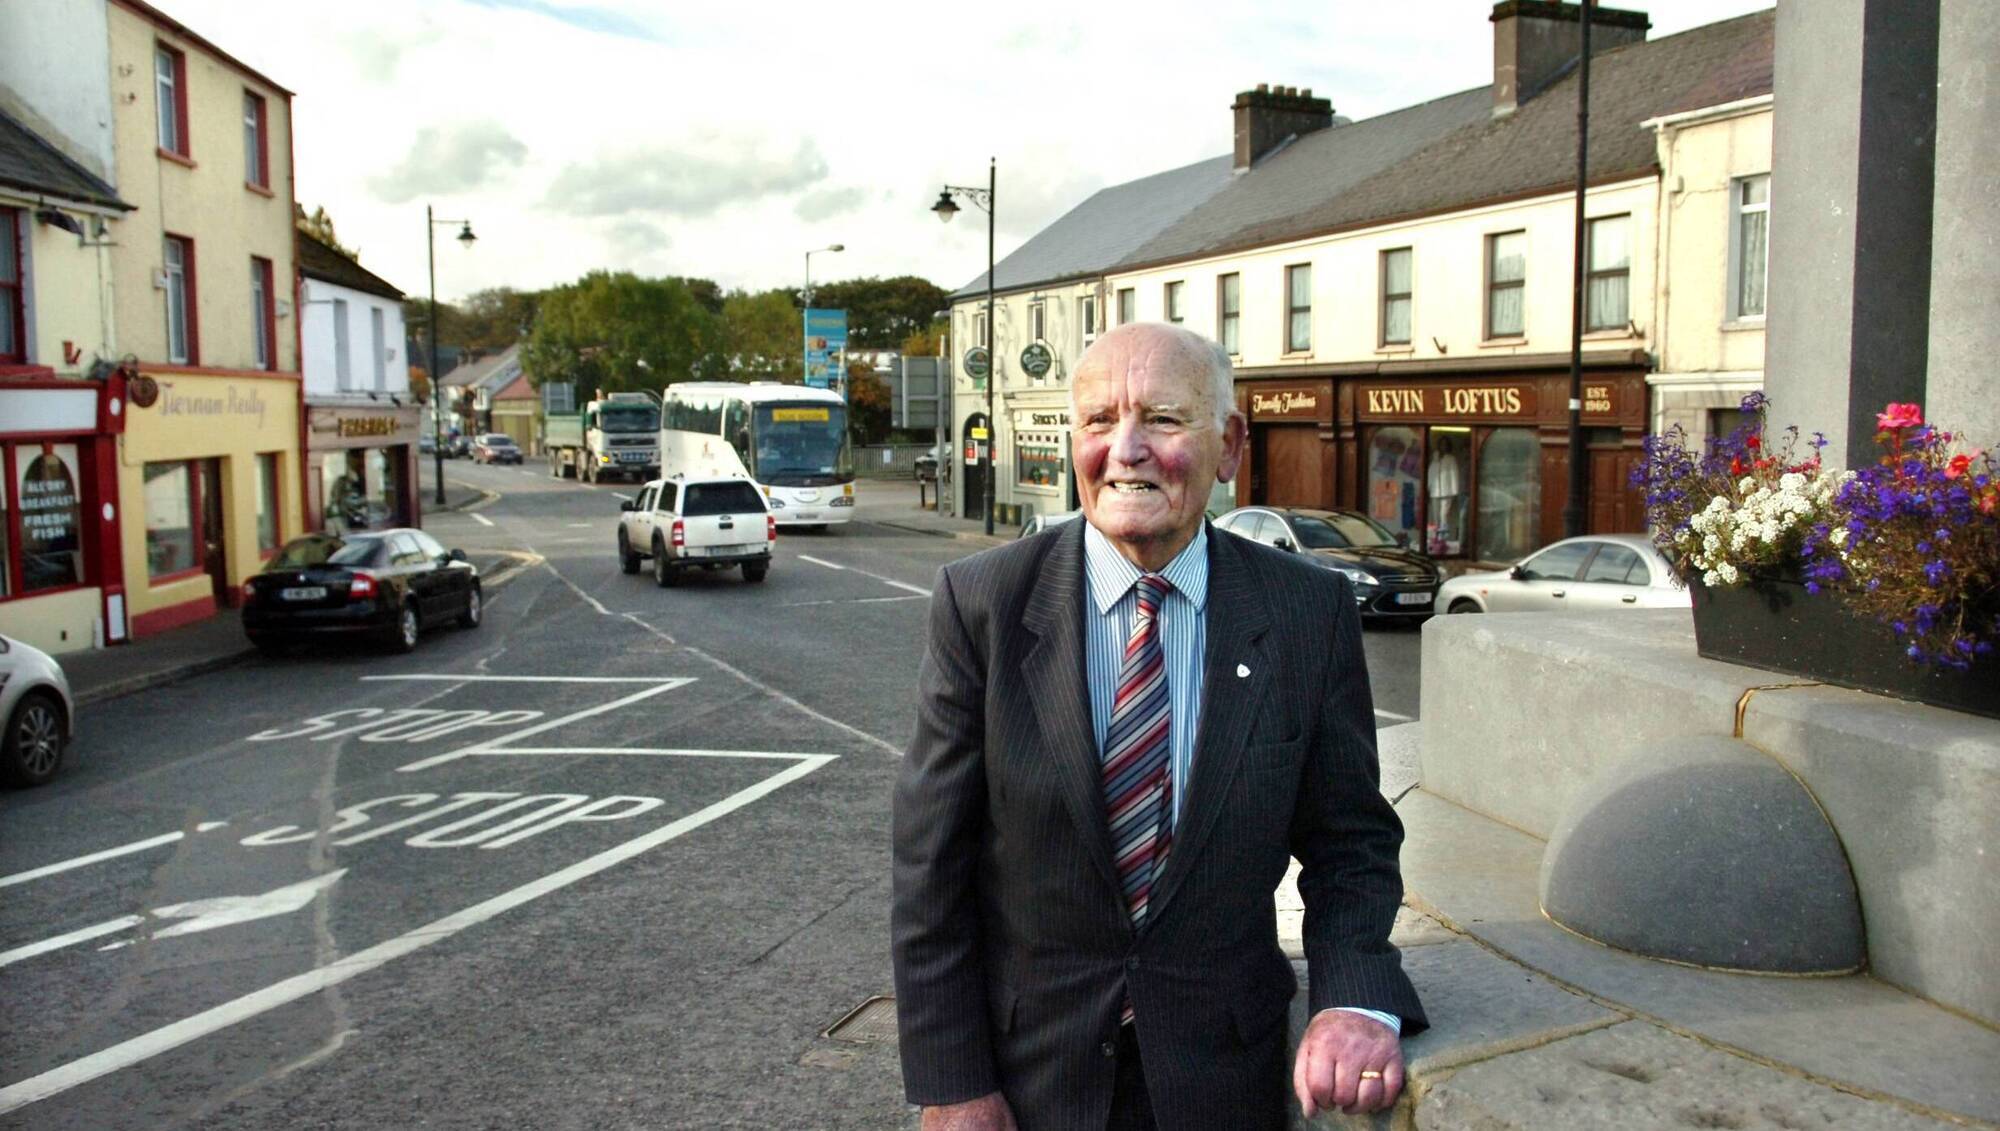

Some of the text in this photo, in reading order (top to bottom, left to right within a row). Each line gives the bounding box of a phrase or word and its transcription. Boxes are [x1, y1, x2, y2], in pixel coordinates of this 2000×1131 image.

[158, 382, 265, 429] Tiernan Reilly
[1253, 391, 1316, 413] Family Fashions
[1368, 388, 1522, 413] KEVIN LOFTUS
[19, 495, 74, 510] BREAKFAST
[23, 512, 72, 527] FRESH
[32, 527, 66, 540] FISH
[246, 708, 545, 742] STOP
[239, 792, 665, 849] STOP
